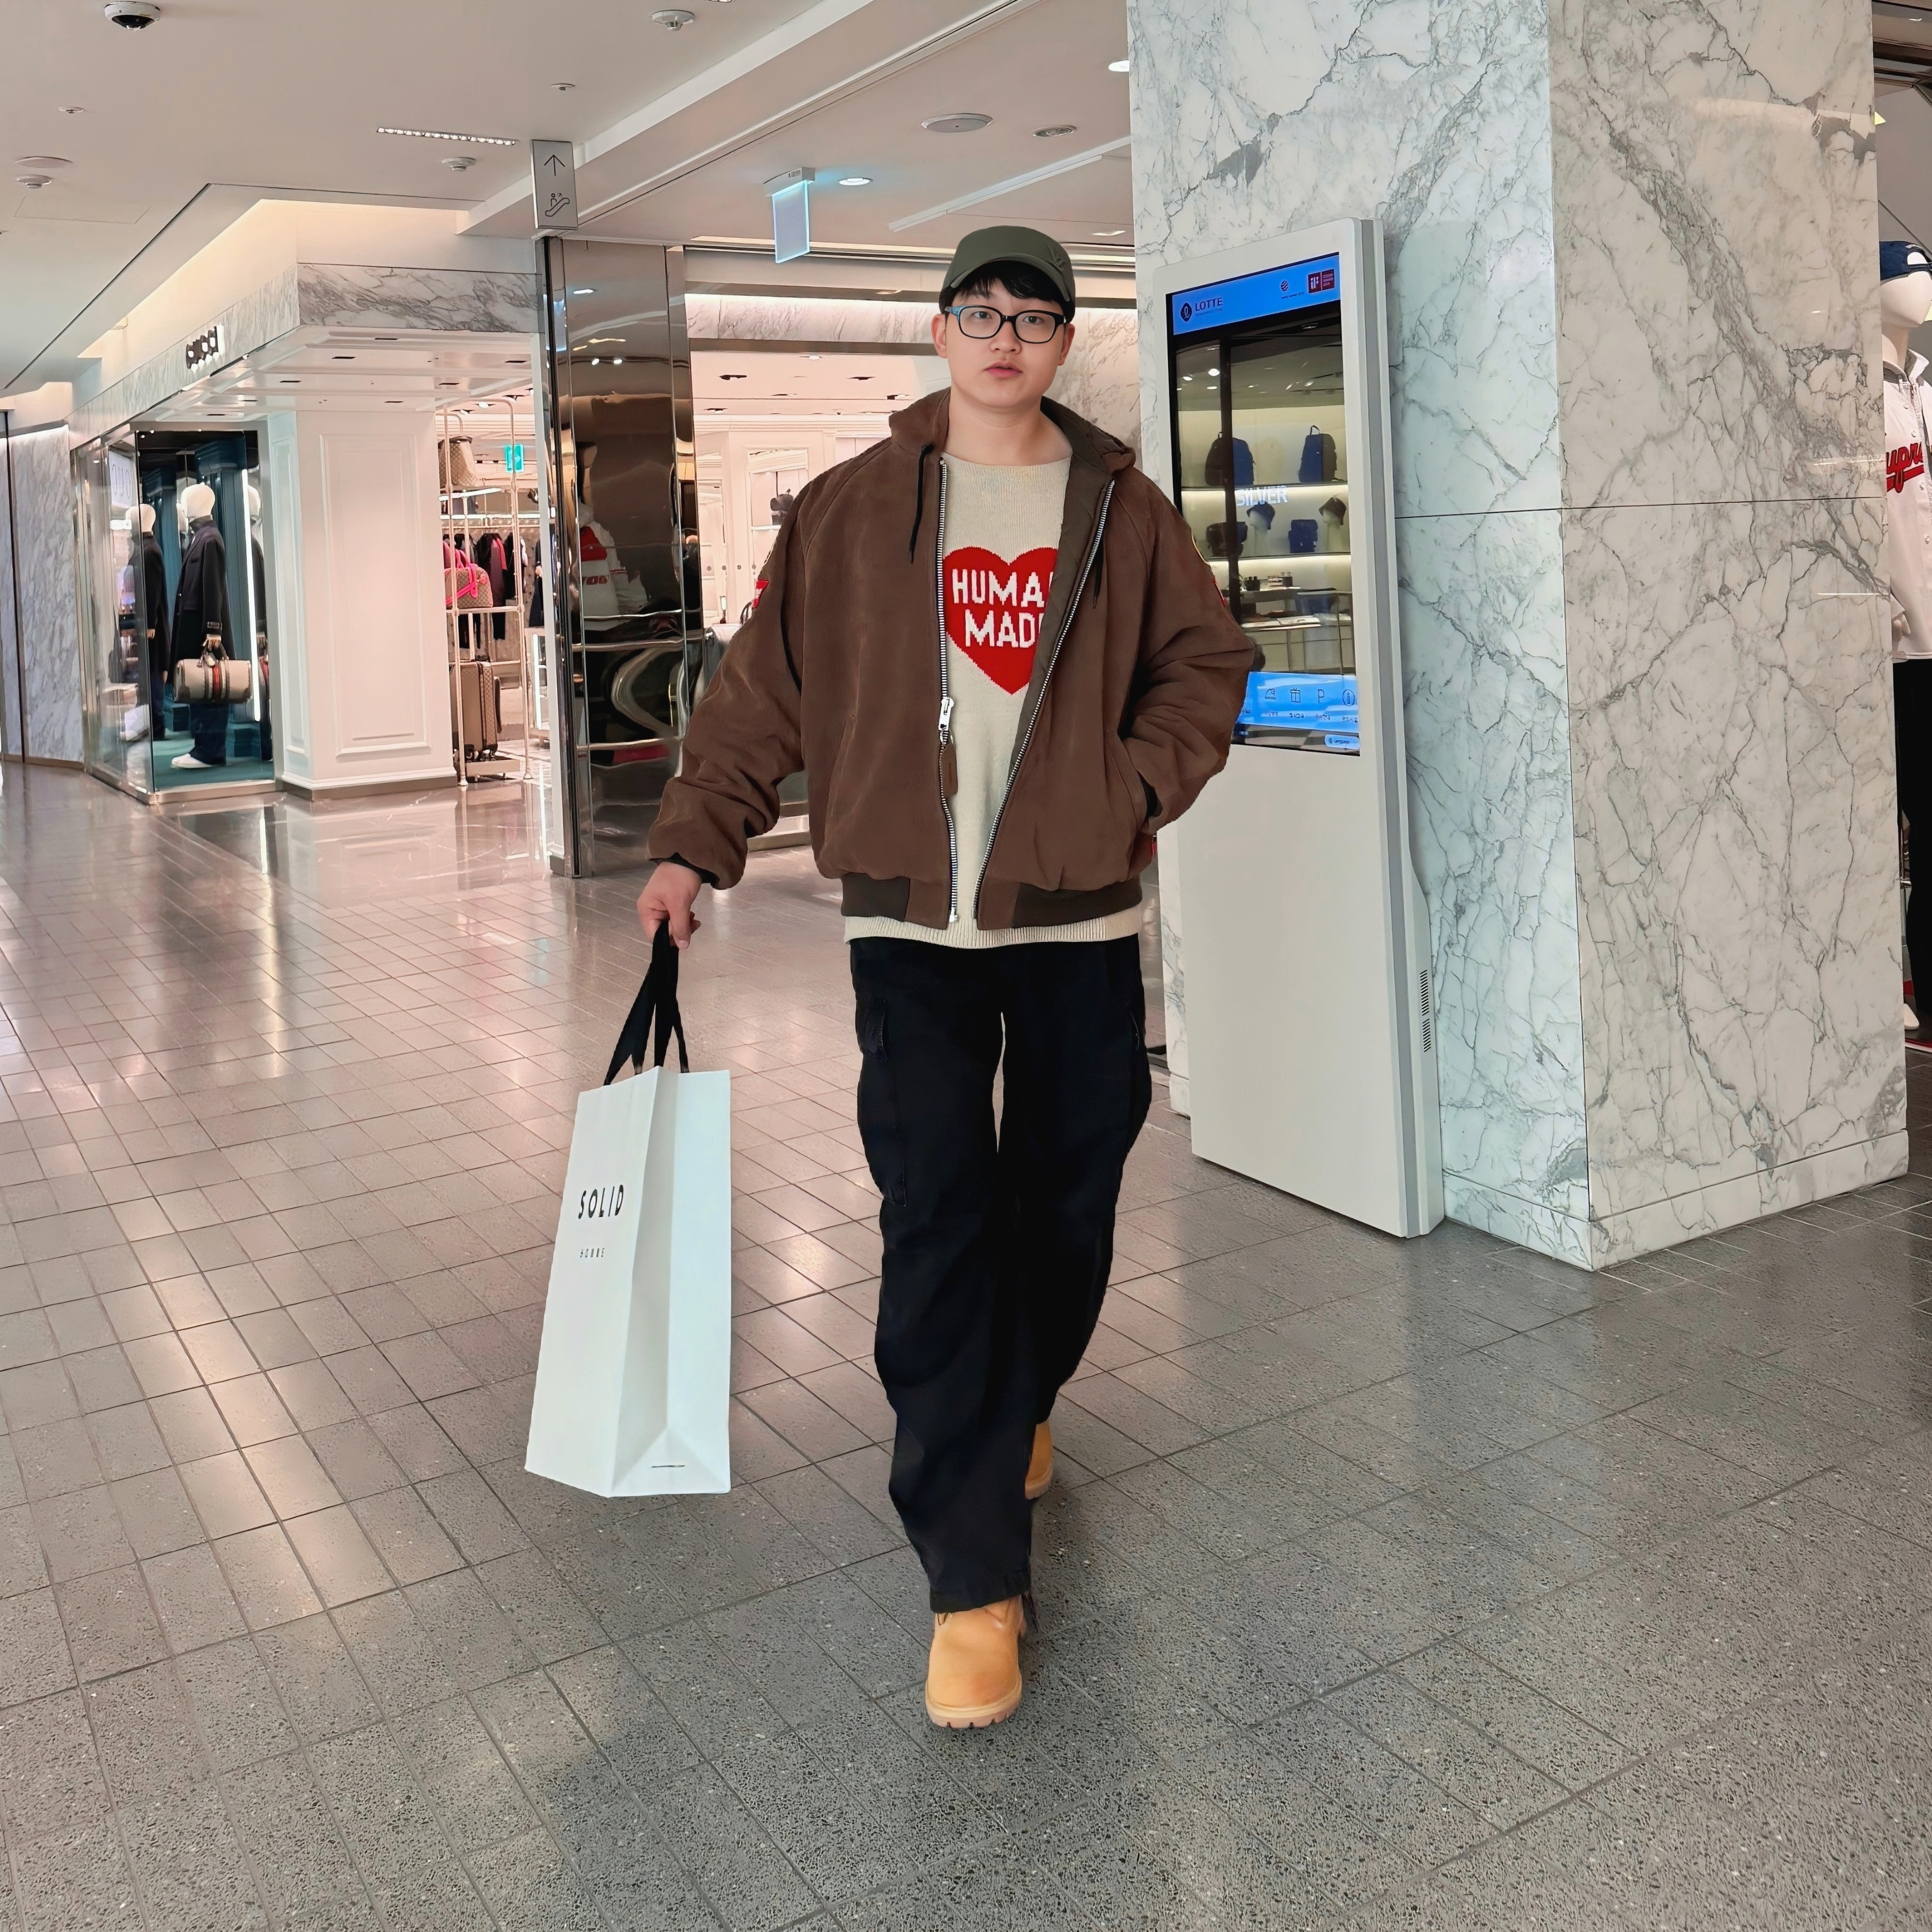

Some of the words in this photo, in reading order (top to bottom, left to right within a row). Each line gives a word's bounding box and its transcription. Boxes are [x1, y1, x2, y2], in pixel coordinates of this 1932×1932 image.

[1195, 297, 1223, 311] LOTTE
[952, 569, 1053, 607] HUMA
[578, 1184, 624, 1220] SOLID
